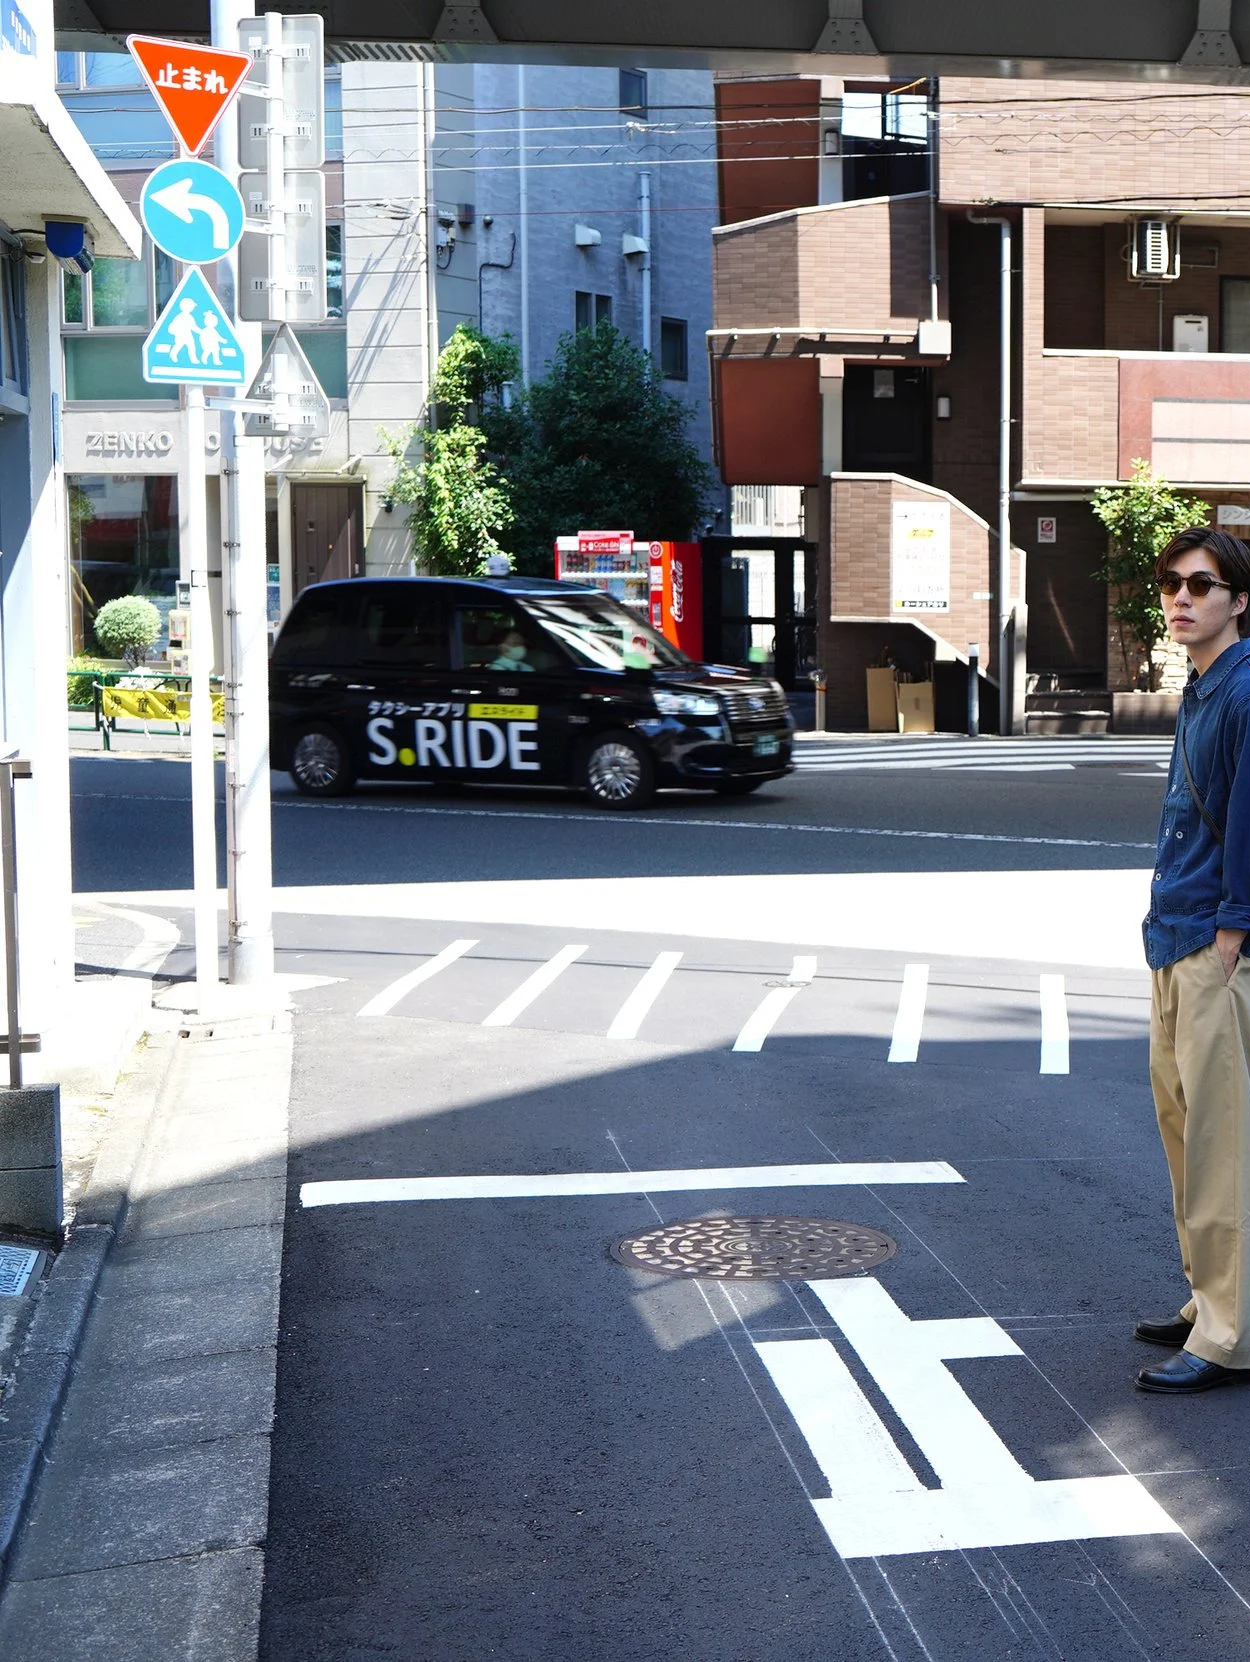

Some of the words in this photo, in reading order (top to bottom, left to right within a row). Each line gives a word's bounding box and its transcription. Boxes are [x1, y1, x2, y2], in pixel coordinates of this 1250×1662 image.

[155, 62, 229, 95] 止まれ
[86, 431, 174, 454] ZENKO
[367, 700, 466, 718] タクシーアプリ
[366, 717, 541, 771] S.RIDE
